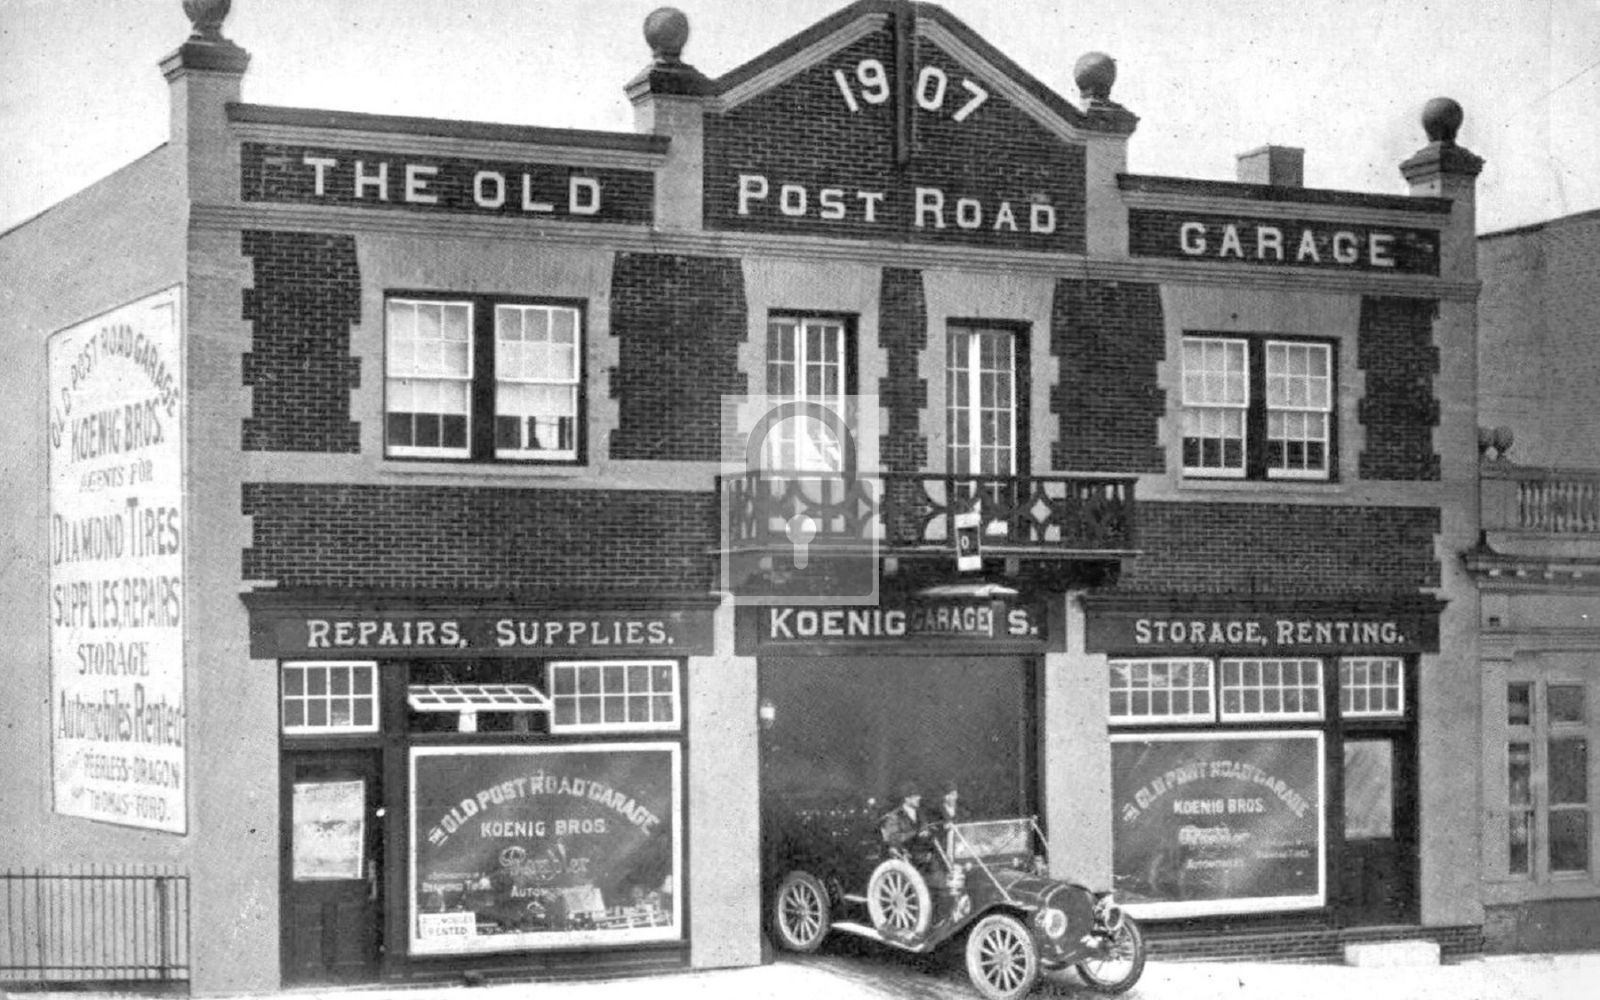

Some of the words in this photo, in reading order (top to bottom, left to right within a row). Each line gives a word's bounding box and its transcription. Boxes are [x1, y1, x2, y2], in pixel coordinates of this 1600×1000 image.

[834, 59, 989, 121] 1907
[303, 157, 439, 203] THE
[473, 170, 602, 215] OLD
[737, 174, 884, 222] POST
[914, 187, 1057, 234] ROAD
[1179, 221, 1397, 268] GARAGE
[100, 323, 134, 360] ROAD
[134, 332, 179, 418] GARAGE
[71, 407, 121, 464] KOENIG
[130, 458, 153, 486] FOR
[53, 513, 124, 566] DIAMOND
[126, 496, 179, 557] TIRES
[123, 575, 180, 628] REPAIRS
[770, 607, 906, 638] KOENIG
[912, 606, 990, 631] GARAGE
[307, 619, 468, 648] REPAIRS,
[495, 619, 675, 646] SUPPLIES.
[1135, 619, 1267, 646] STORAGE,
[1276, 619, 1405, 644] RENTING.
[77, 641, 150, 677] STORAGE
[134, 682, 182, 747] Rented
[440, 797, 479, 835] OLD
[475, 776, 528, 811] POST
[530, 775, 586, 798] ROAD
[586, 781, 660, 836] GARAGE
[1173, 799, 1224, 815] KOENIG
[480, 820, 545, 838] KOENIG
